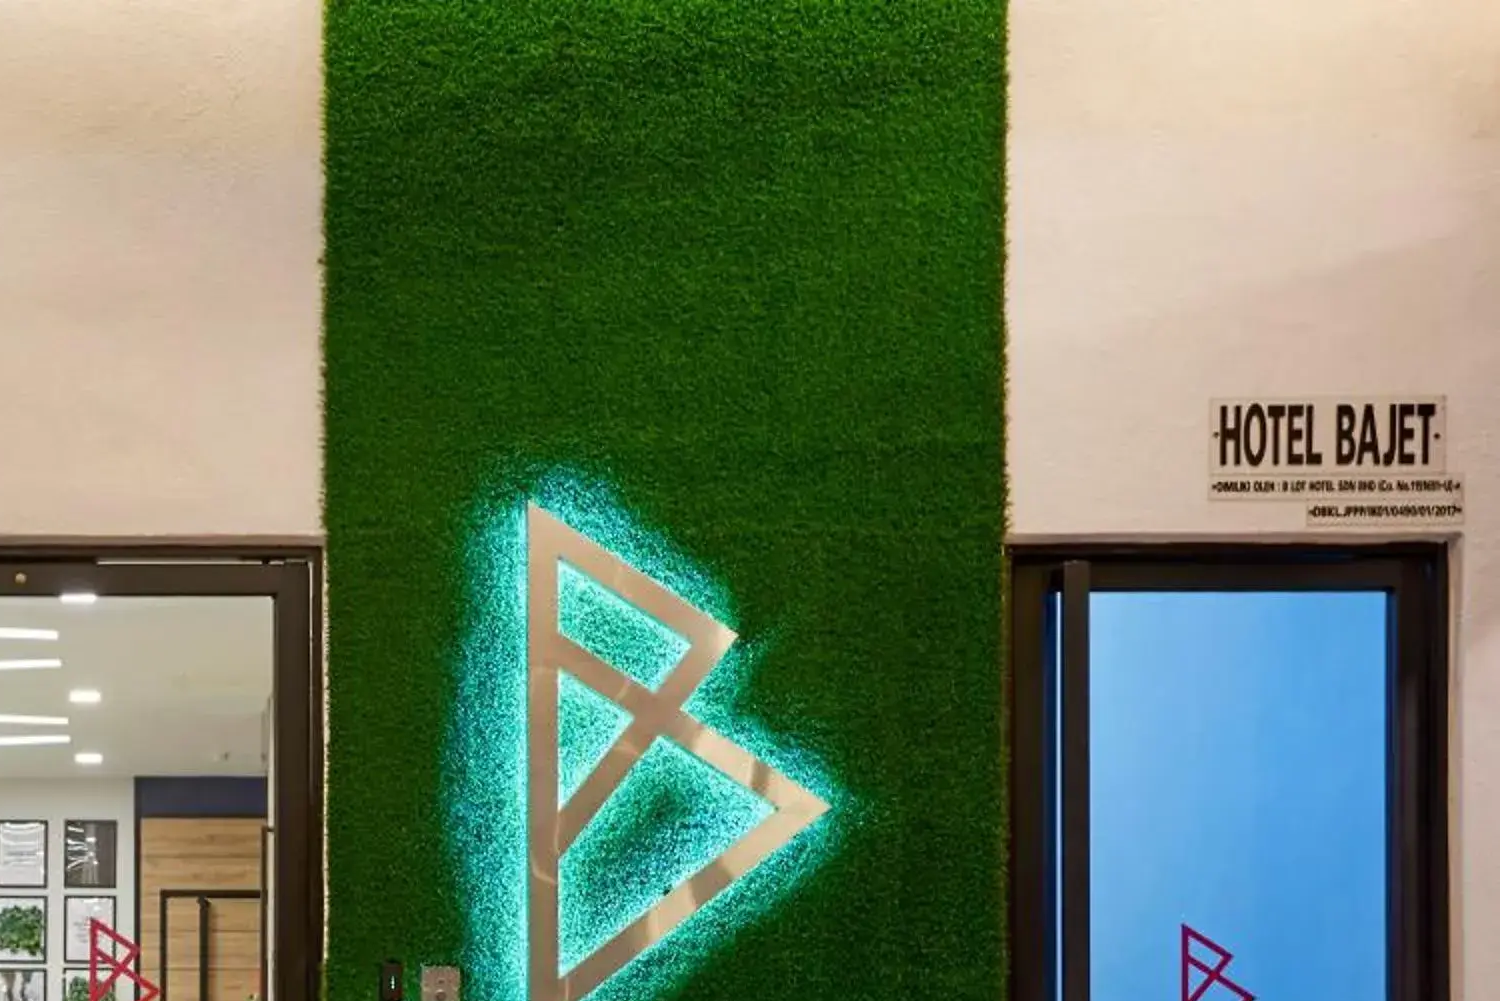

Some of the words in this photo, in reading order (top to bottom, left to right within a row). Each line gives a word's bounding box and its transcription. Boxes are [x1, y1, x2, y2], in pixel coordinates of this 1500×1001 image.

[1219, 404, 1322, 466] HOTEL
[1336, 404, 1436, 465] BAJET
[1309, 480, 1335, 492] HOTEL
